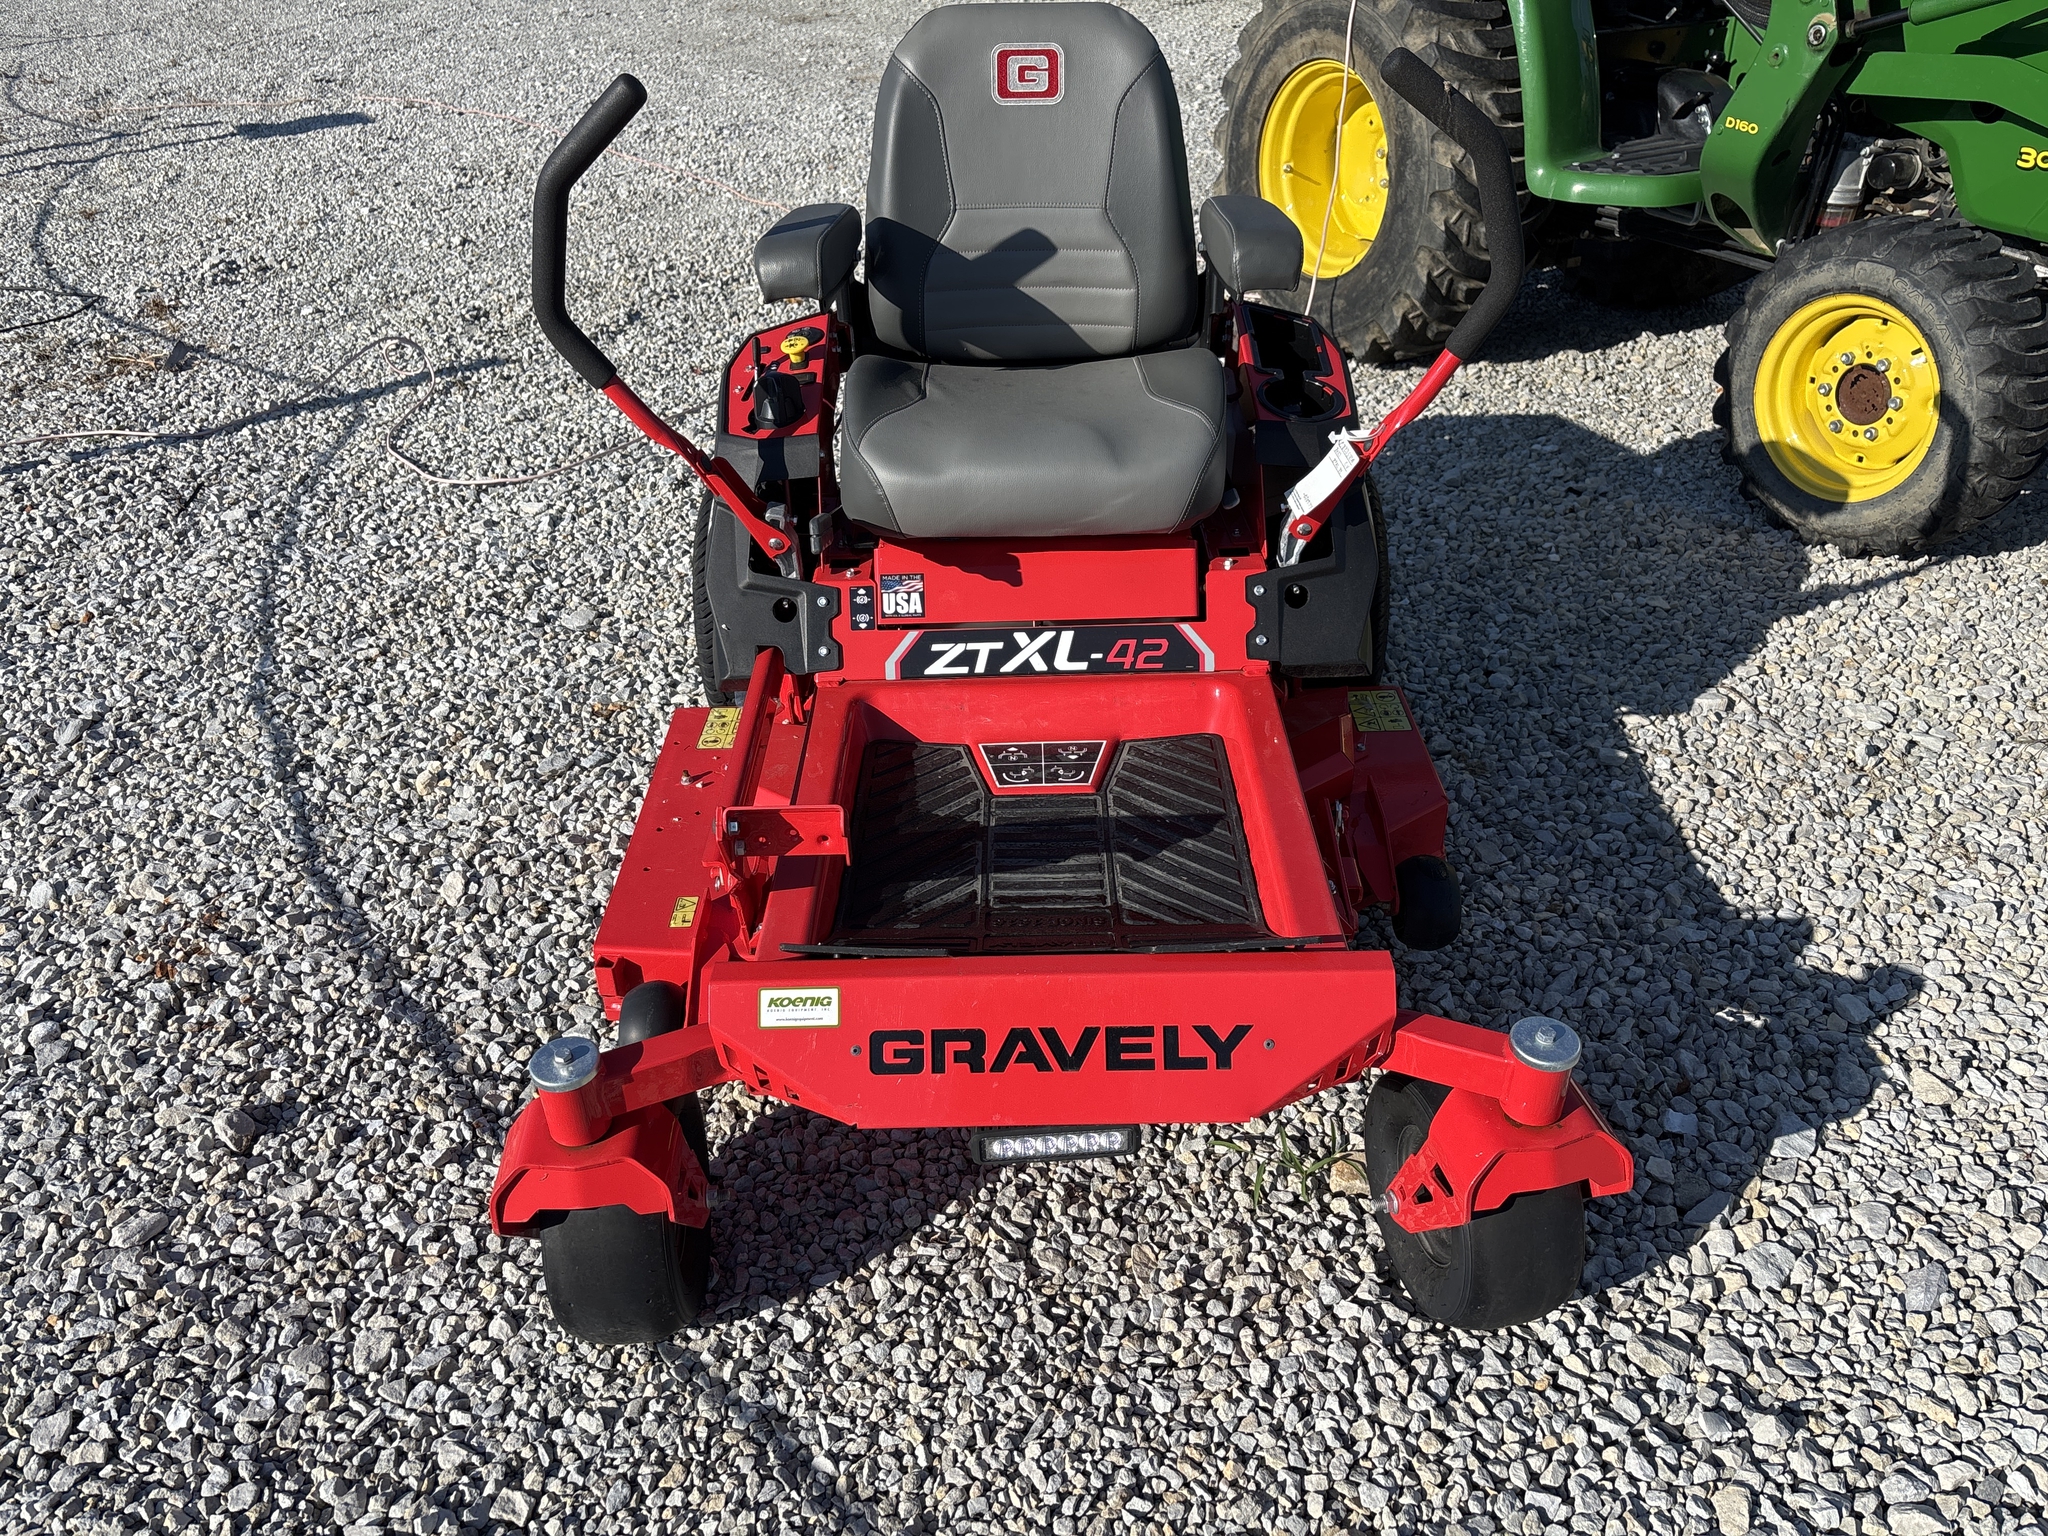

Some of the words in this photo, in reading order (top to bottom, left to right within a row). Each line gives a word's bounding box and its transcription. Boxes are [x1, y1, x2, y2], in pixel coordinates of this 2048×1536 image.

[1725, 116, 1759, 135] D160
[1892, 277, 1967, 387] GALAXY
[882, 592, 923, 614] USA
[869, 1024, 1254, 1075] GRAVELY
